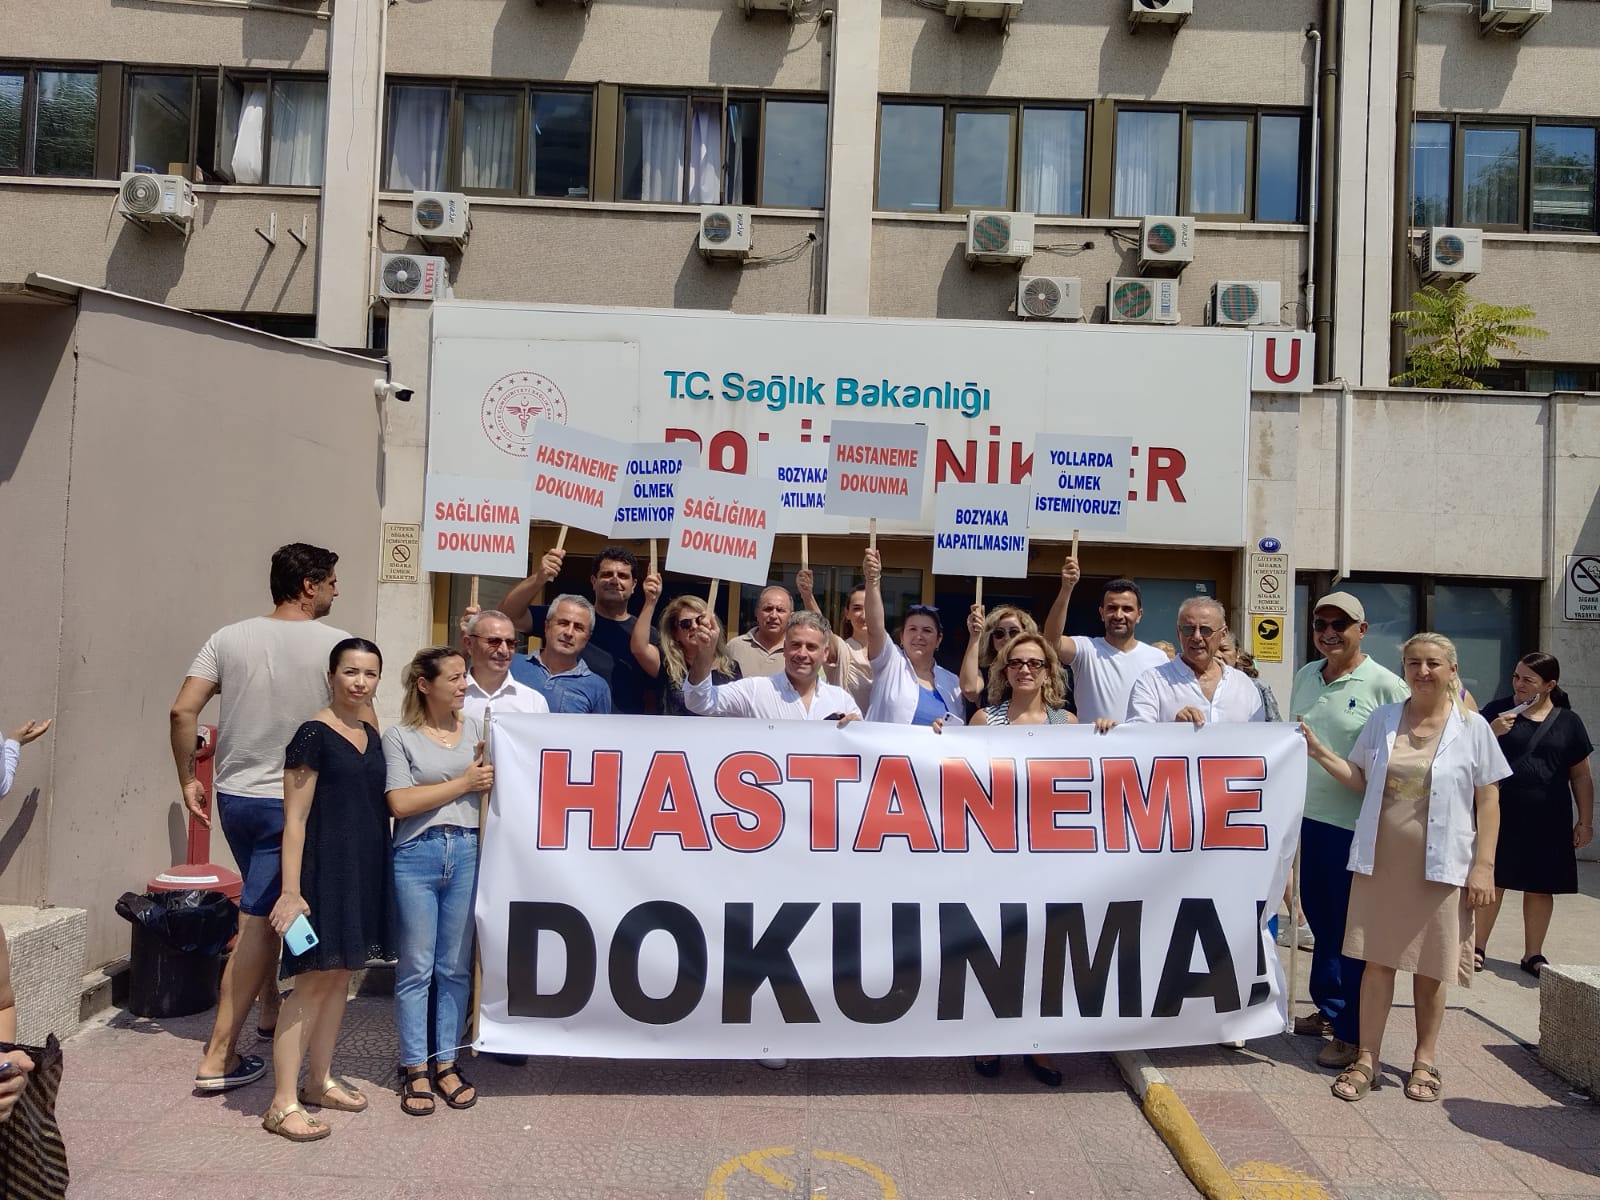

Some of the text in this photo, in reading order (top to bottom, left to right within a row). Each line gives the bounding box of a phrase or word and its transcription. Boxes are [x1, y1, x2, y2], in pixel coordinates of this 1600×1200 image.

[424, 260, 435, 295] VESTEL
[1265, 337, 1302, 384] U
[664, 370, 990, 418] T.C. Sağlık Bakanlığı
[536, 444, 619, 483] HASTANEME
[836, 444, 919, 468] HASTANEME
[1050, 450, 1113, 468] YOLLARDA
[535, 474, 604, 508] DOKUNMA
[633, 480, 674, 498] ÖLMEK
[840, 473, 909, 496] DOKUNMA
[1058, 470, 1101, 491] ÖLMEK
[435, 497, 520, 524] SAĞLIĞIMA
[683, 496, 767, 529] SAĞLIĞIMA
[1035, 492, 1121, 515] İSTEMİYORUZ!
[955, 509, 1009, 526] BOZYAKA
[437, 532, 515, 554] DOKUNMA
[681, 529, 757, 560] DOKUNMA
[937, 533, 1025, 551] KAPATILMASIN!
[536, 748, 1269, 855] HASTANEME
[508, 898, 1271, 1024] DOKUNMA!
